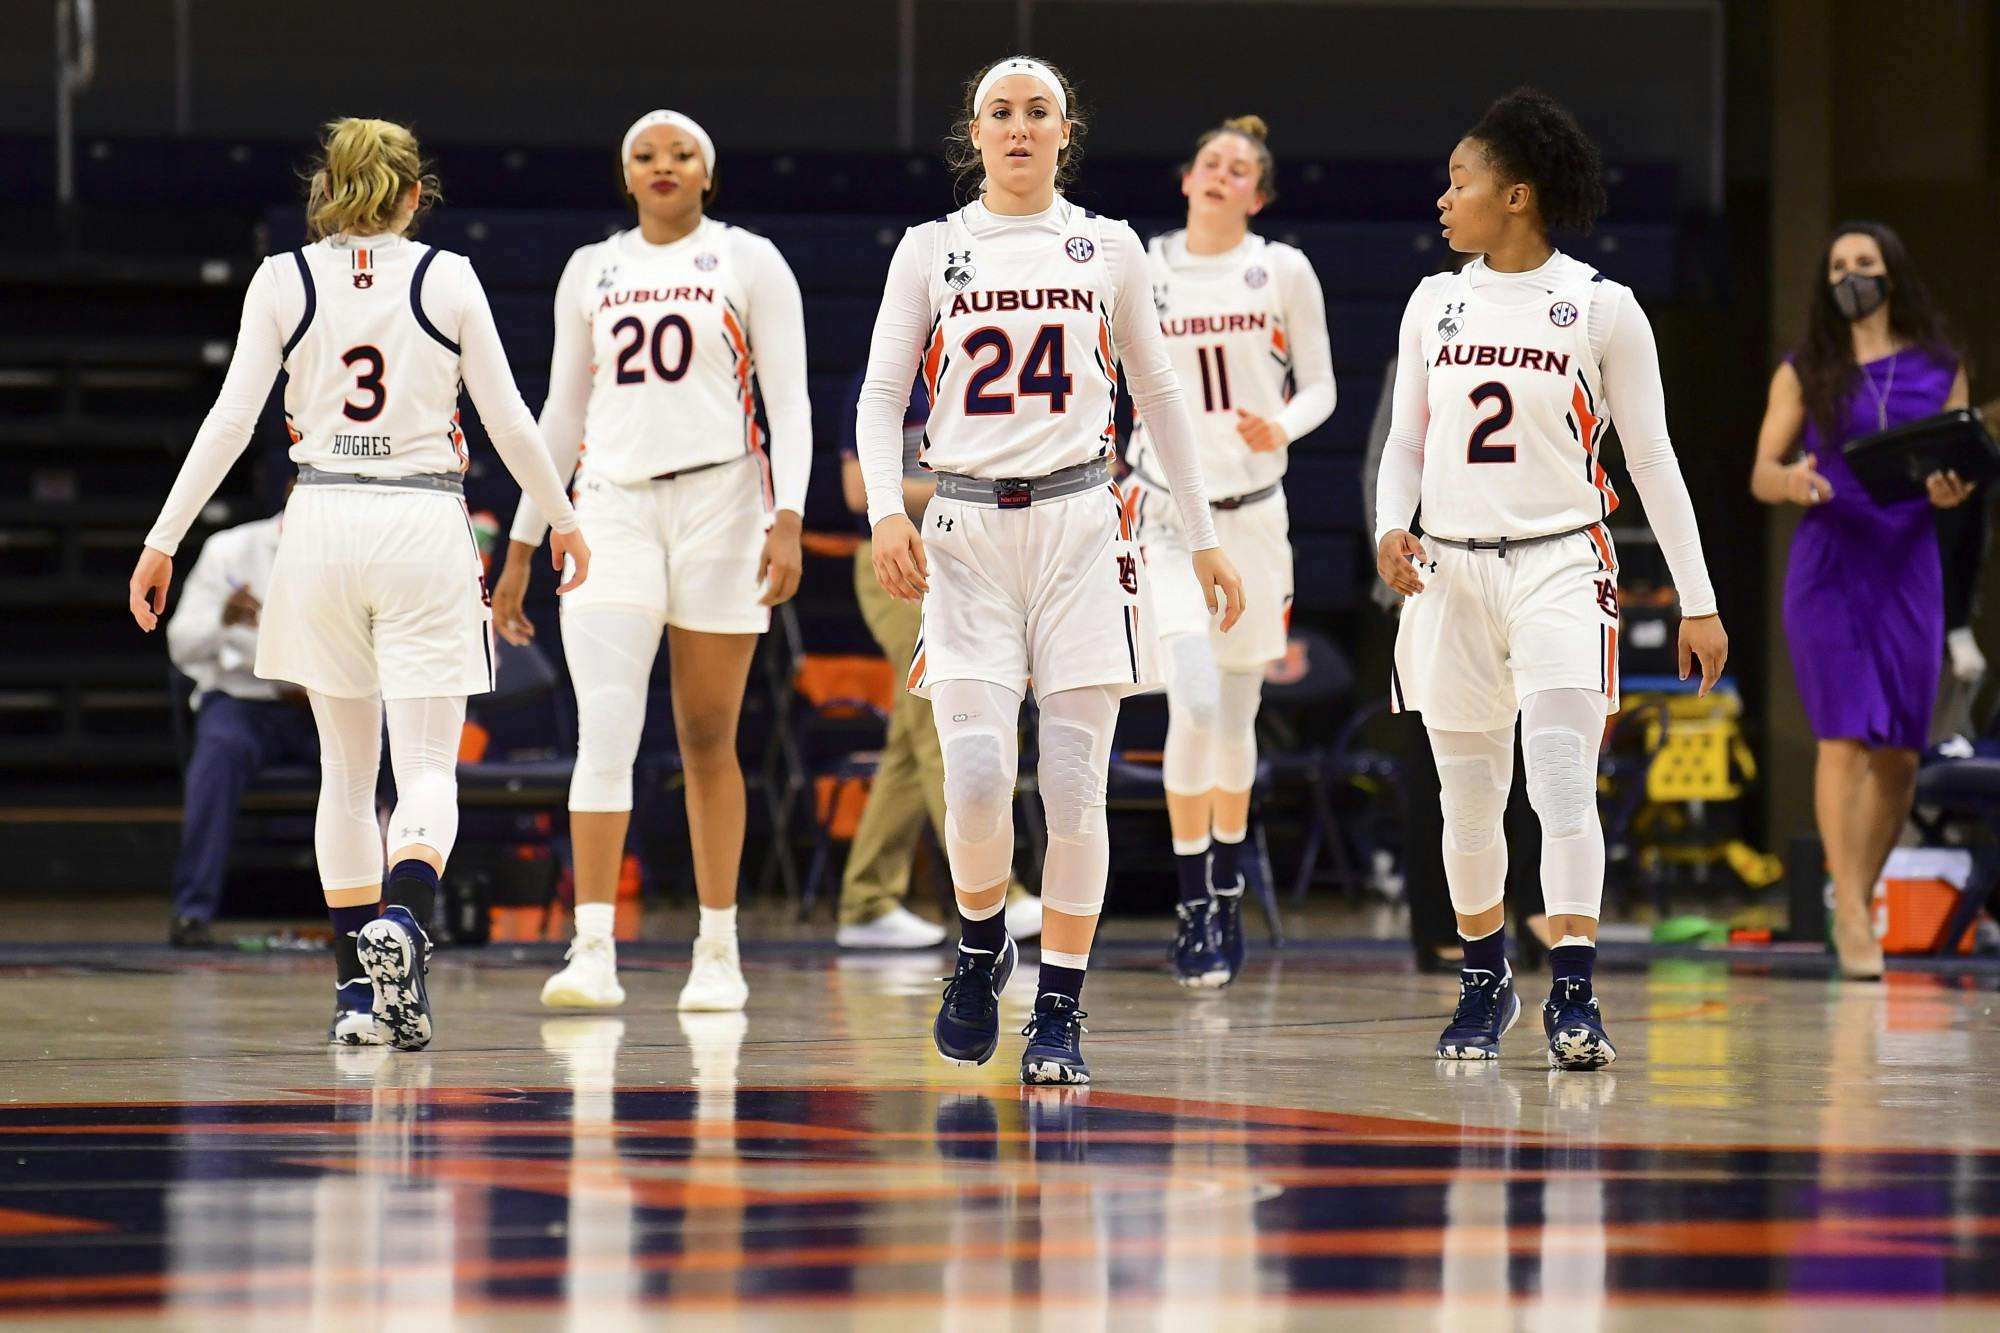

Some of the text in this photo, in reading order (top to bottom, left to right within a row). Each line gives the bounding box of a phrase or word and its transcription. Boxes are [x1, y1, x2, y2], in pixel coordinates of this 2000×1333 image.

[1065, 236, 1095, 263] SEC
[600, 287, 715, 313] AUBURN
[949, 288, 1094, 318] AUBURN
[1549, 301, 1578, 328] SEC
[611, 314, 693, 387] 20
[1434, 344, 1570, 376] AUBURN
[341, 344, 388, 423] 3
[962, 324, 1073, 416] 24
[1196, 343, 1232, 412] 11
[1467, 381, 1517, 464] 2
[332, 435, 391, 456] HUGHES
